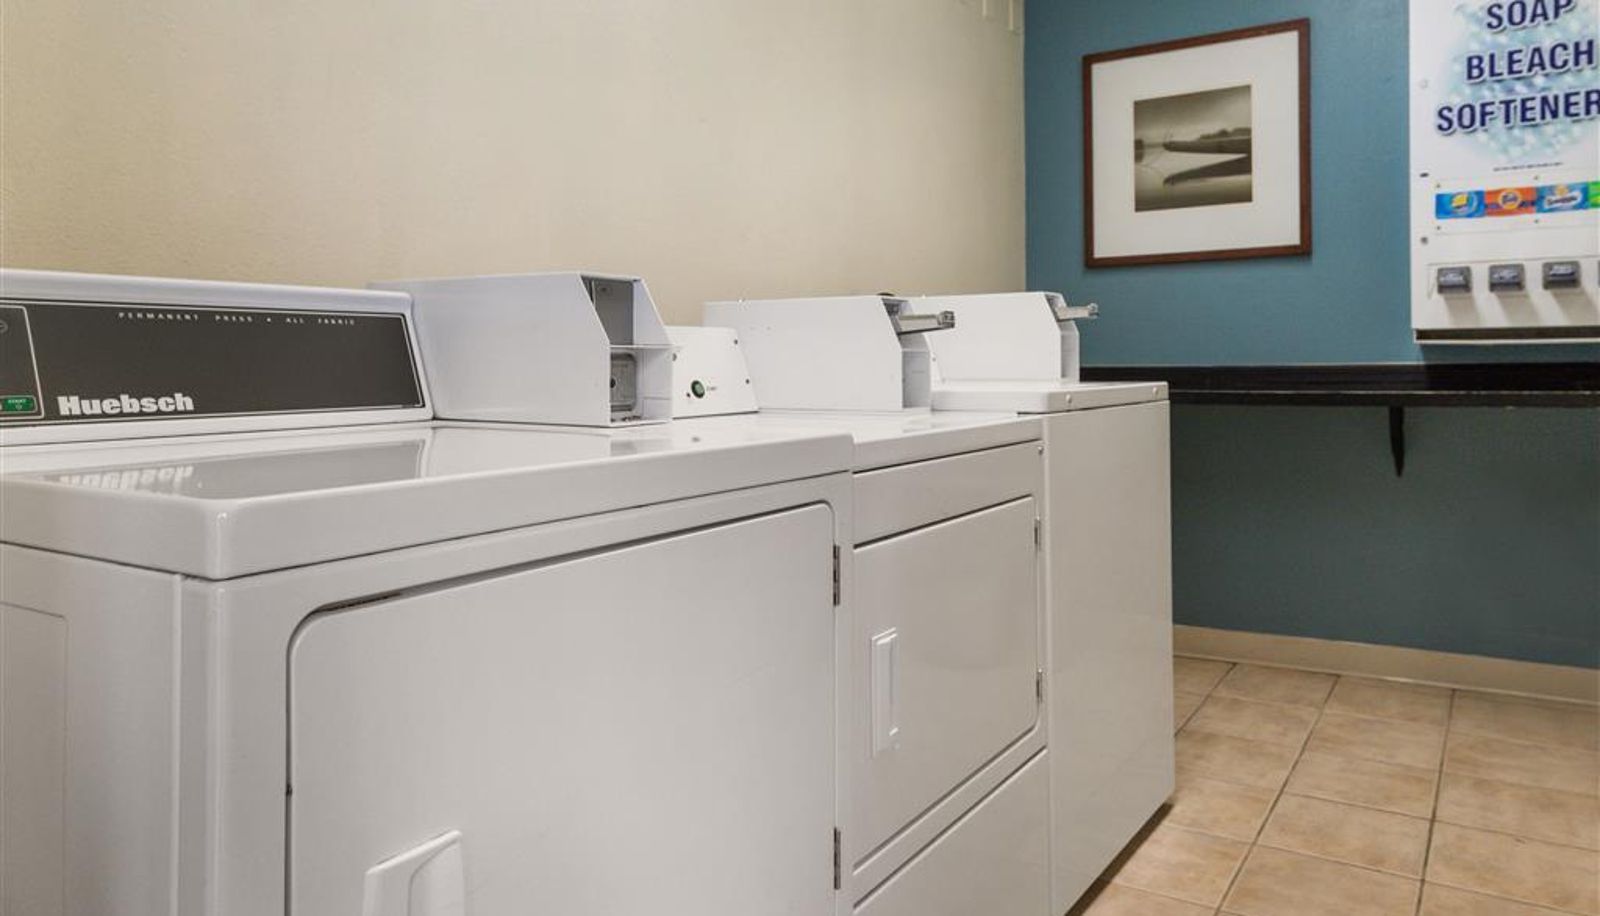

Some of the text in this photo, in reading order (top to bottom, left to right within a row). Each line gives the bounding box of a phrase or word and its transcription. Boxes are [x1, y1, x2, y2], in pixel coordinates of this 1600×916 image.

[1486, 0, 1573, 30] SOAP
[1466, 39, 1595, 81] BLEACH
[1437, 89, 1600, 132] SOFTENER
[118, 311, 198, 321] PERMANENT
[215, 314, 252, 323] PRESS
[57, 392, 194, 415] Huebsch
